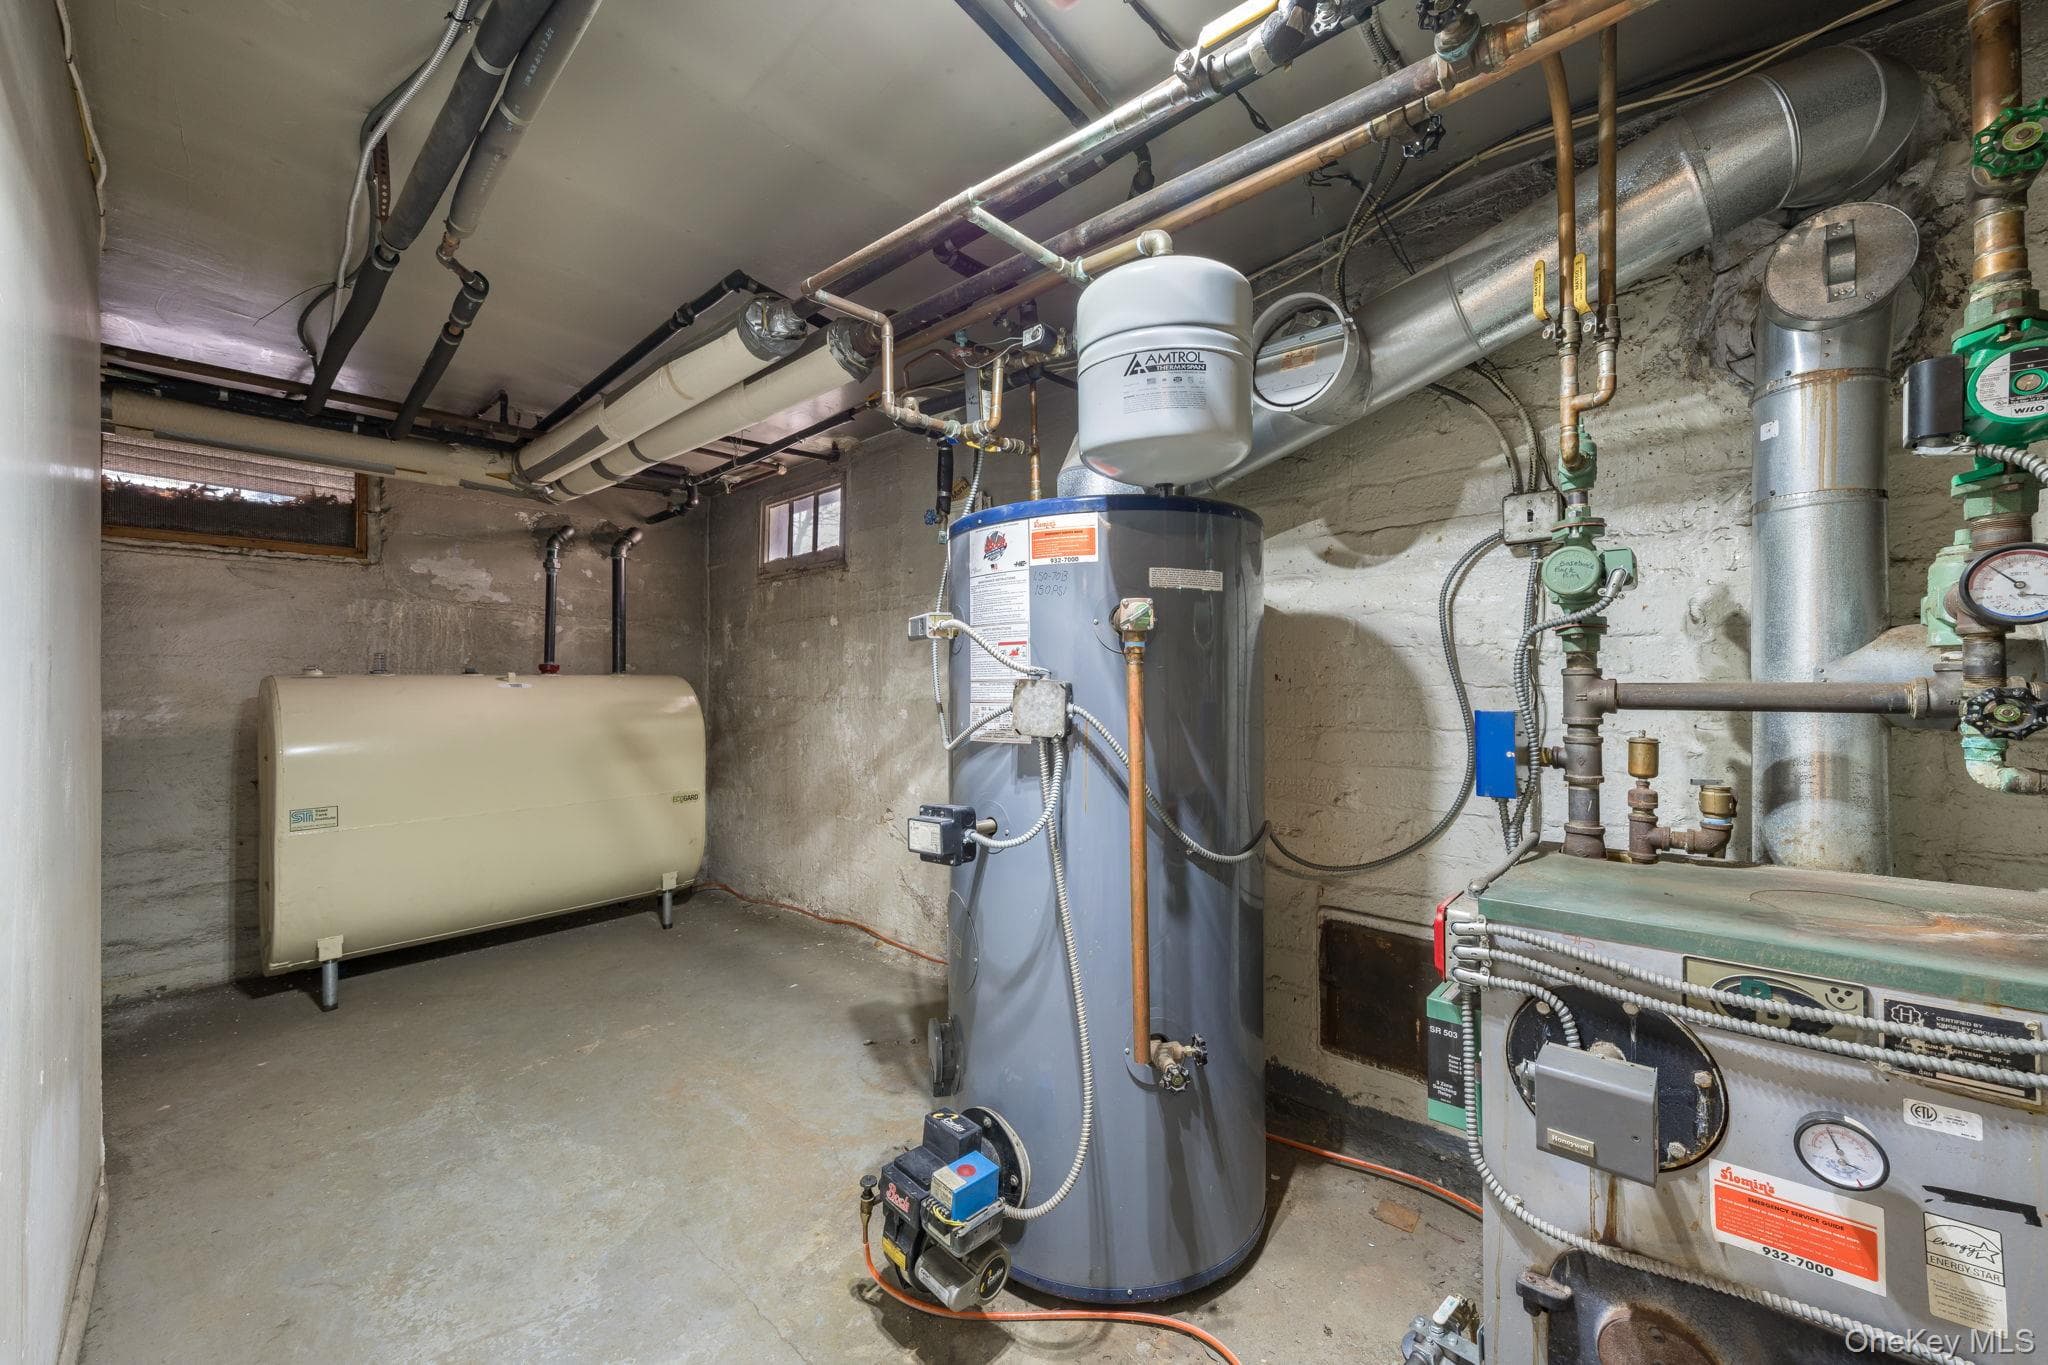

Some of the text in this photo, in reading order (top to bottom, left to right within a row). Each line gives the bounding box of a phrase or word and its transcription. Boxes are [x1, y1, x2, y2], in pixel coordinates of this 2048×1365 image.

[1145, 351, 1204, 365] AMTROL
[2014, 405, 2045, 414] WILO
[1935, 1016, 1973, 1028] CERTIFIED
[1429, 1025, 1458, 1039] SR 503
[1551, 1134, 1589, 1151] Honeywell
[1720, 1166, 1776, 1196] Slomin's
[1748, 1197, 1845, 1231] EMERGENCY SERVICE GUIDE
[1928, 1237, 1978, 1257] energy
[1762, 1246, 1835, 1278] 932-7000
[1930, 1255, 2000, 1282] ENERGY STAR
